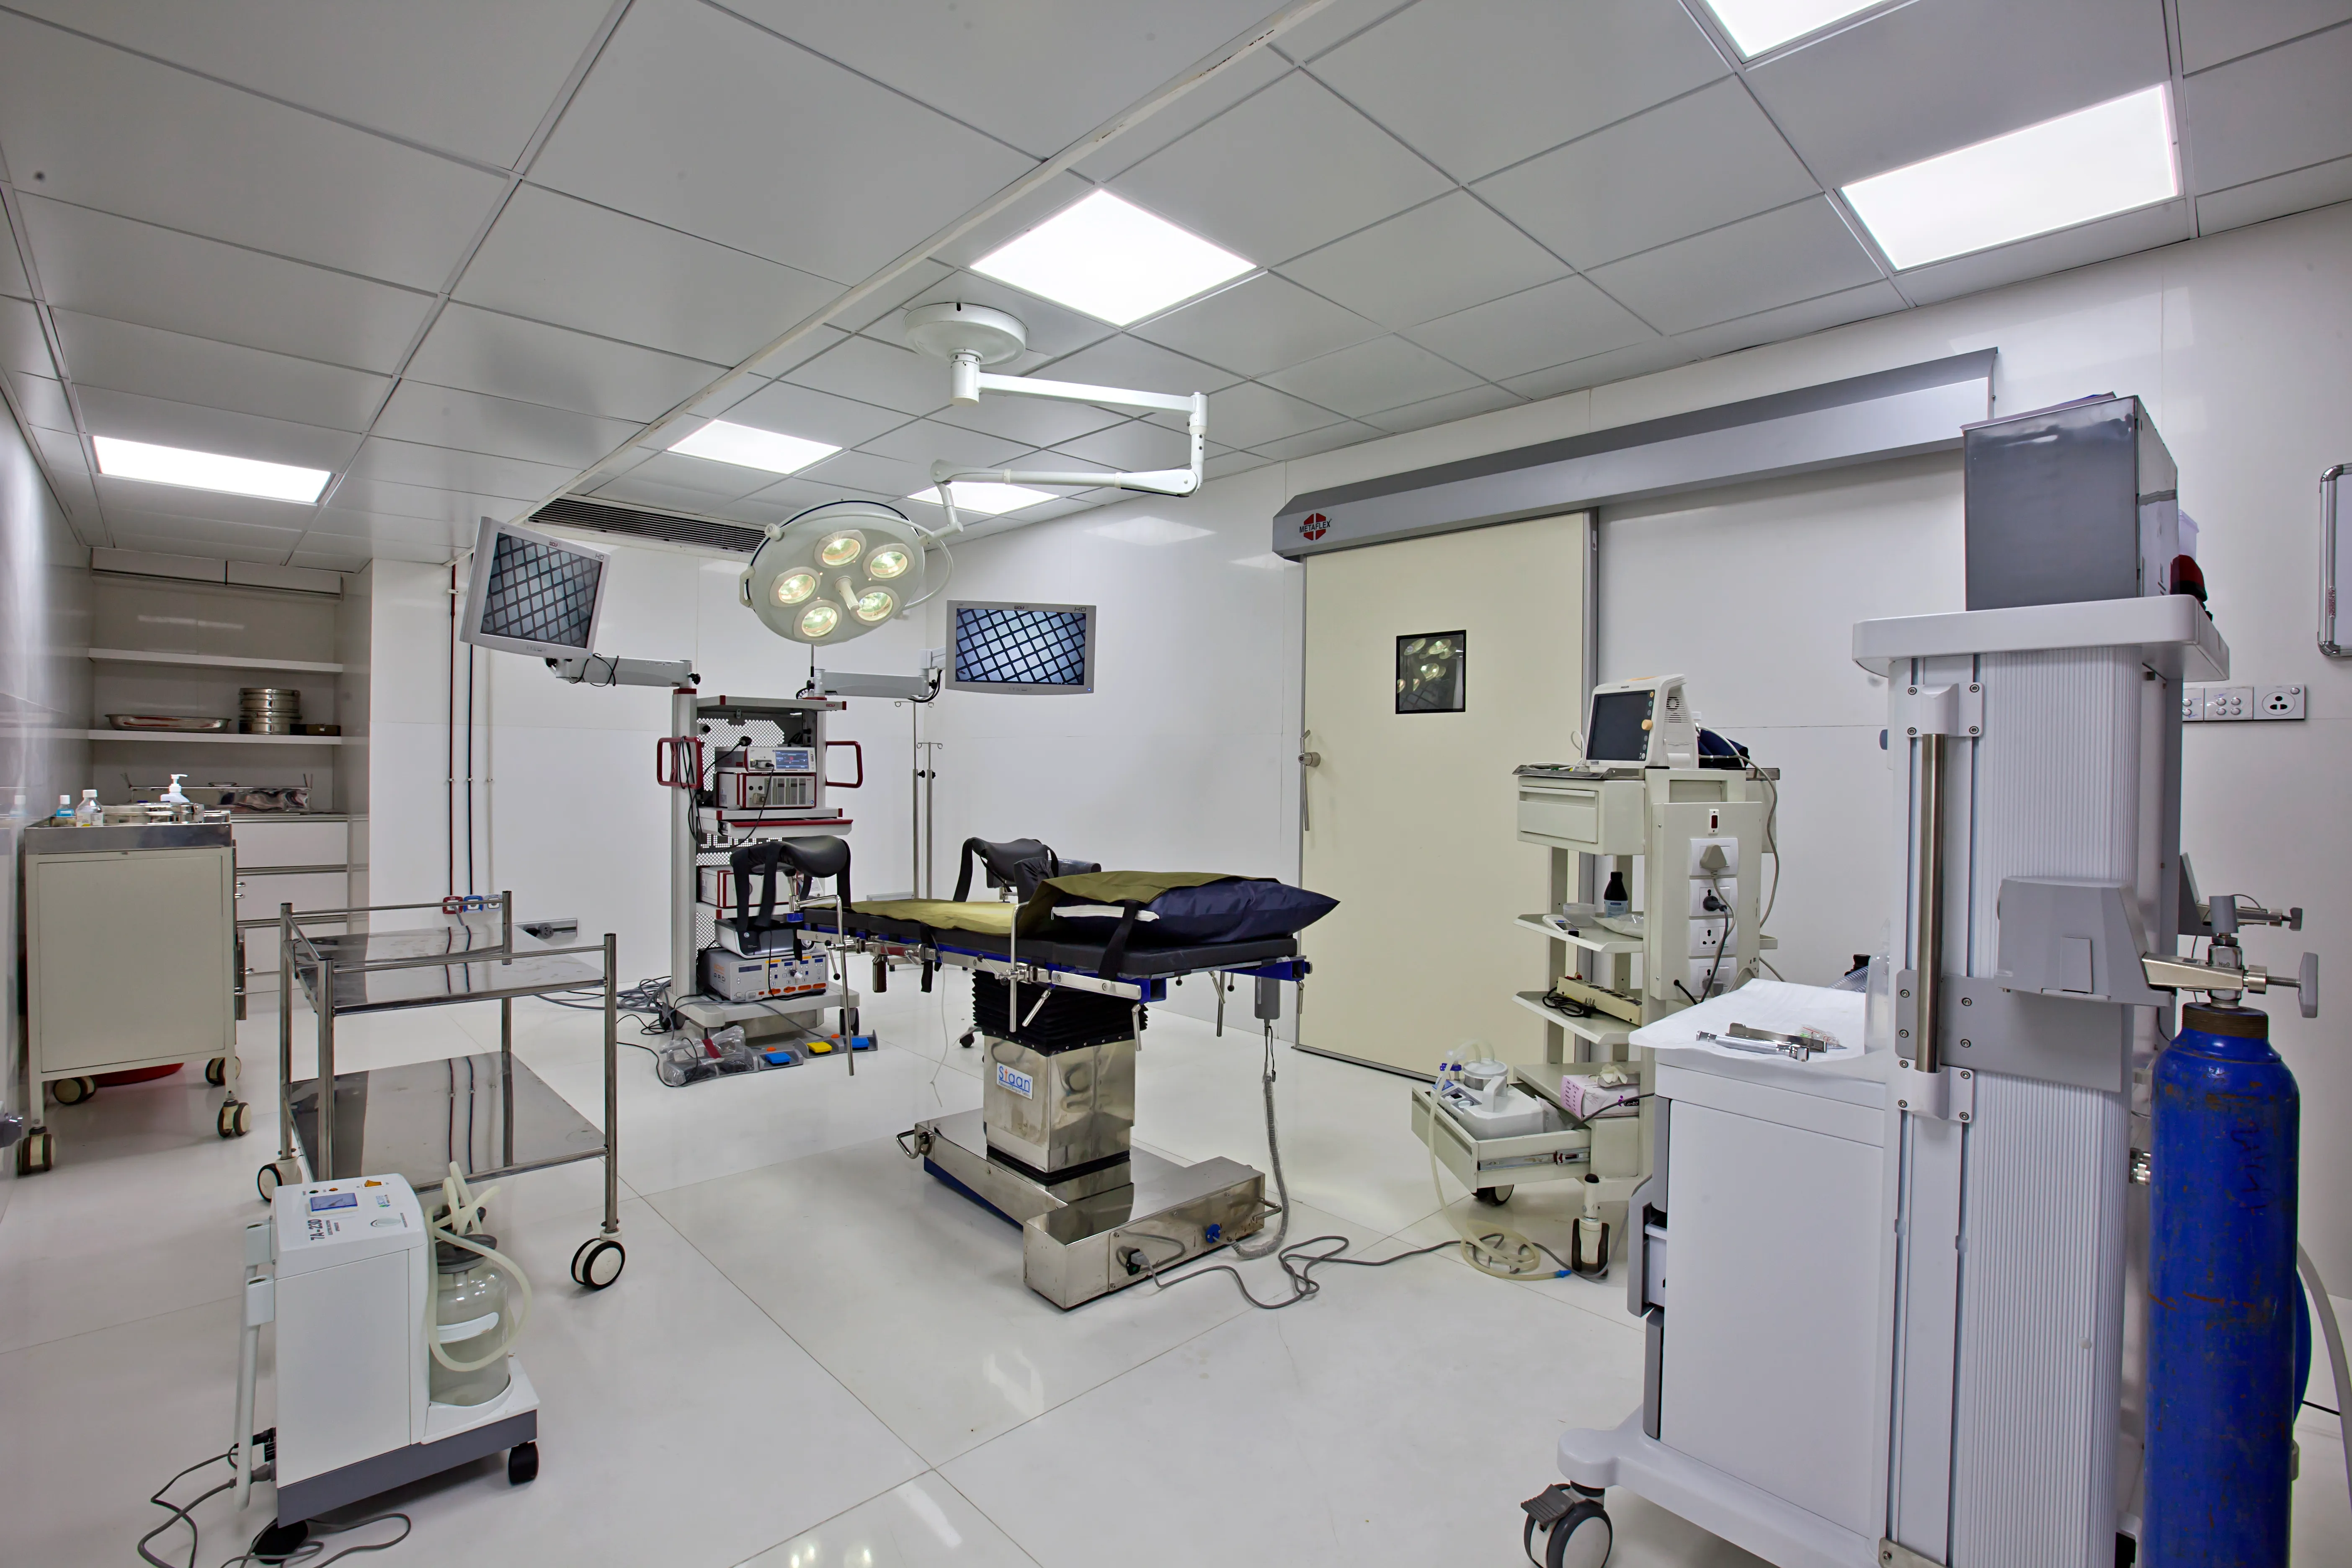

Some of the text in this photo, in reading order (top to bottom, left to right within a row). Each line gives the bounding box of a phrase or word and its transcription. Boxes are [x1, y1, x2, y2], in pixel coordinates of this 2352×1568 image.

[1299, 521, 1331, 533] METAFLEX
[999, 1066, 1030, 1091] Staan
[307, 1219, 325, 1240] 7A-23D
